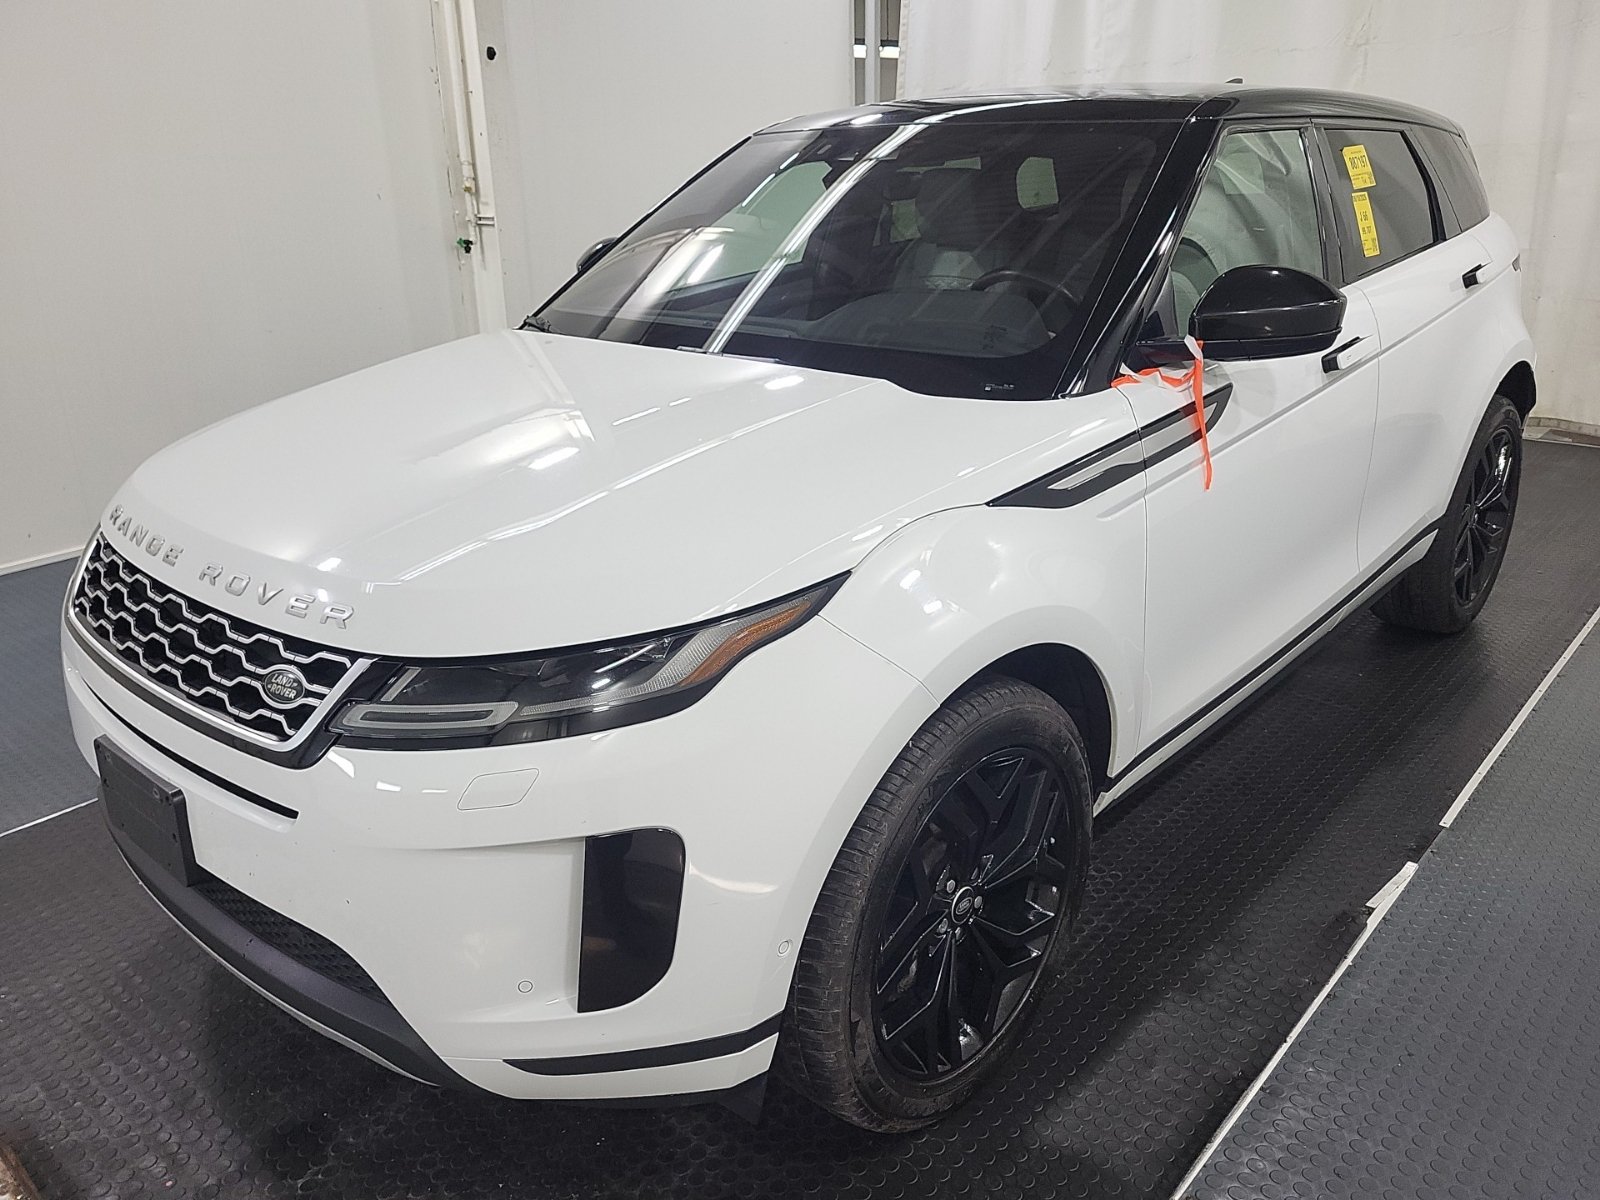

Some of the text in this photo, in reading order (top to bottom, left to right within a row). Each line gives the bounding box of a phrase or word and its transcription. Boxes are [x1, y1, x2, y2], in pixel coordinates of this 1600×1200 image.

[109, 504, 354, 629] RANGE ROVER
[271, 673, 294, 688] LAND
[270, 683, 297, 699] ROVER
